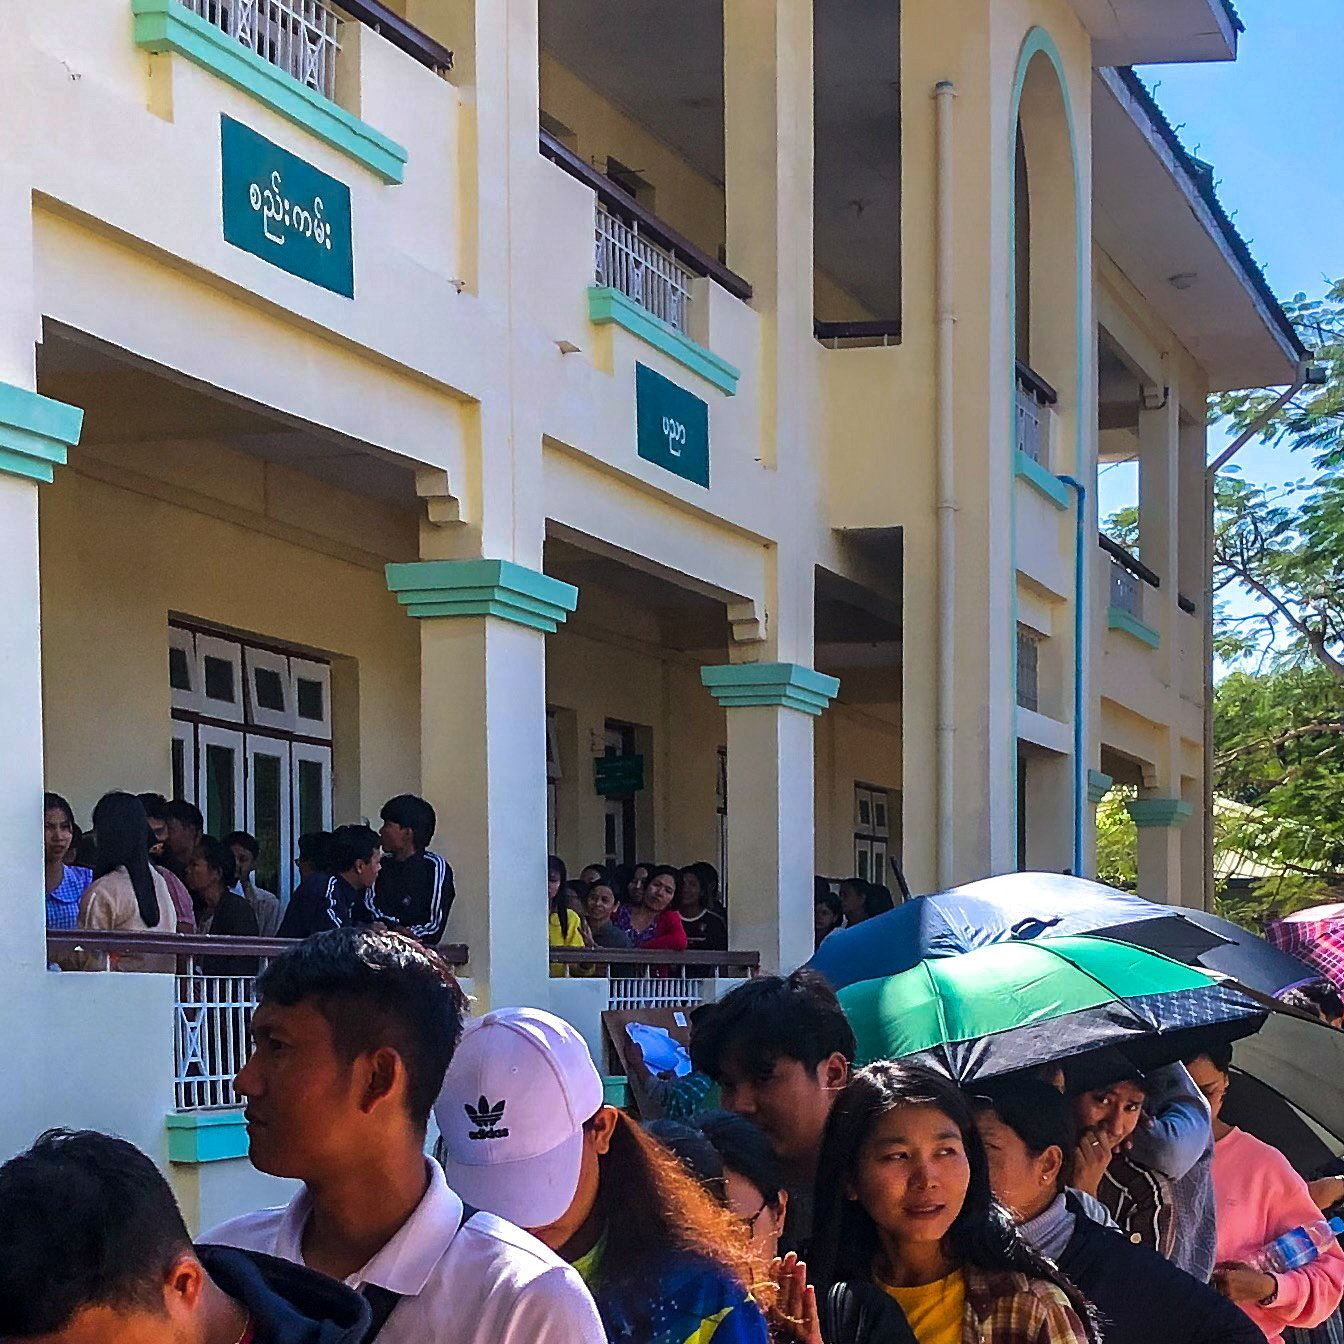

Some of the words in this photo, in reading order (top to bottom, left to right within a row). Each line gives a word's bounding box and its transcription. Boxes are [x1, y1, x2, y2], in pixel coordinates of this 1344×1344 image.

[249, 170, 332, 251] စည်းကမ်း
[662, 415, 686, 457] ပညာ
[468, 1127, 510, 1140] adidas
